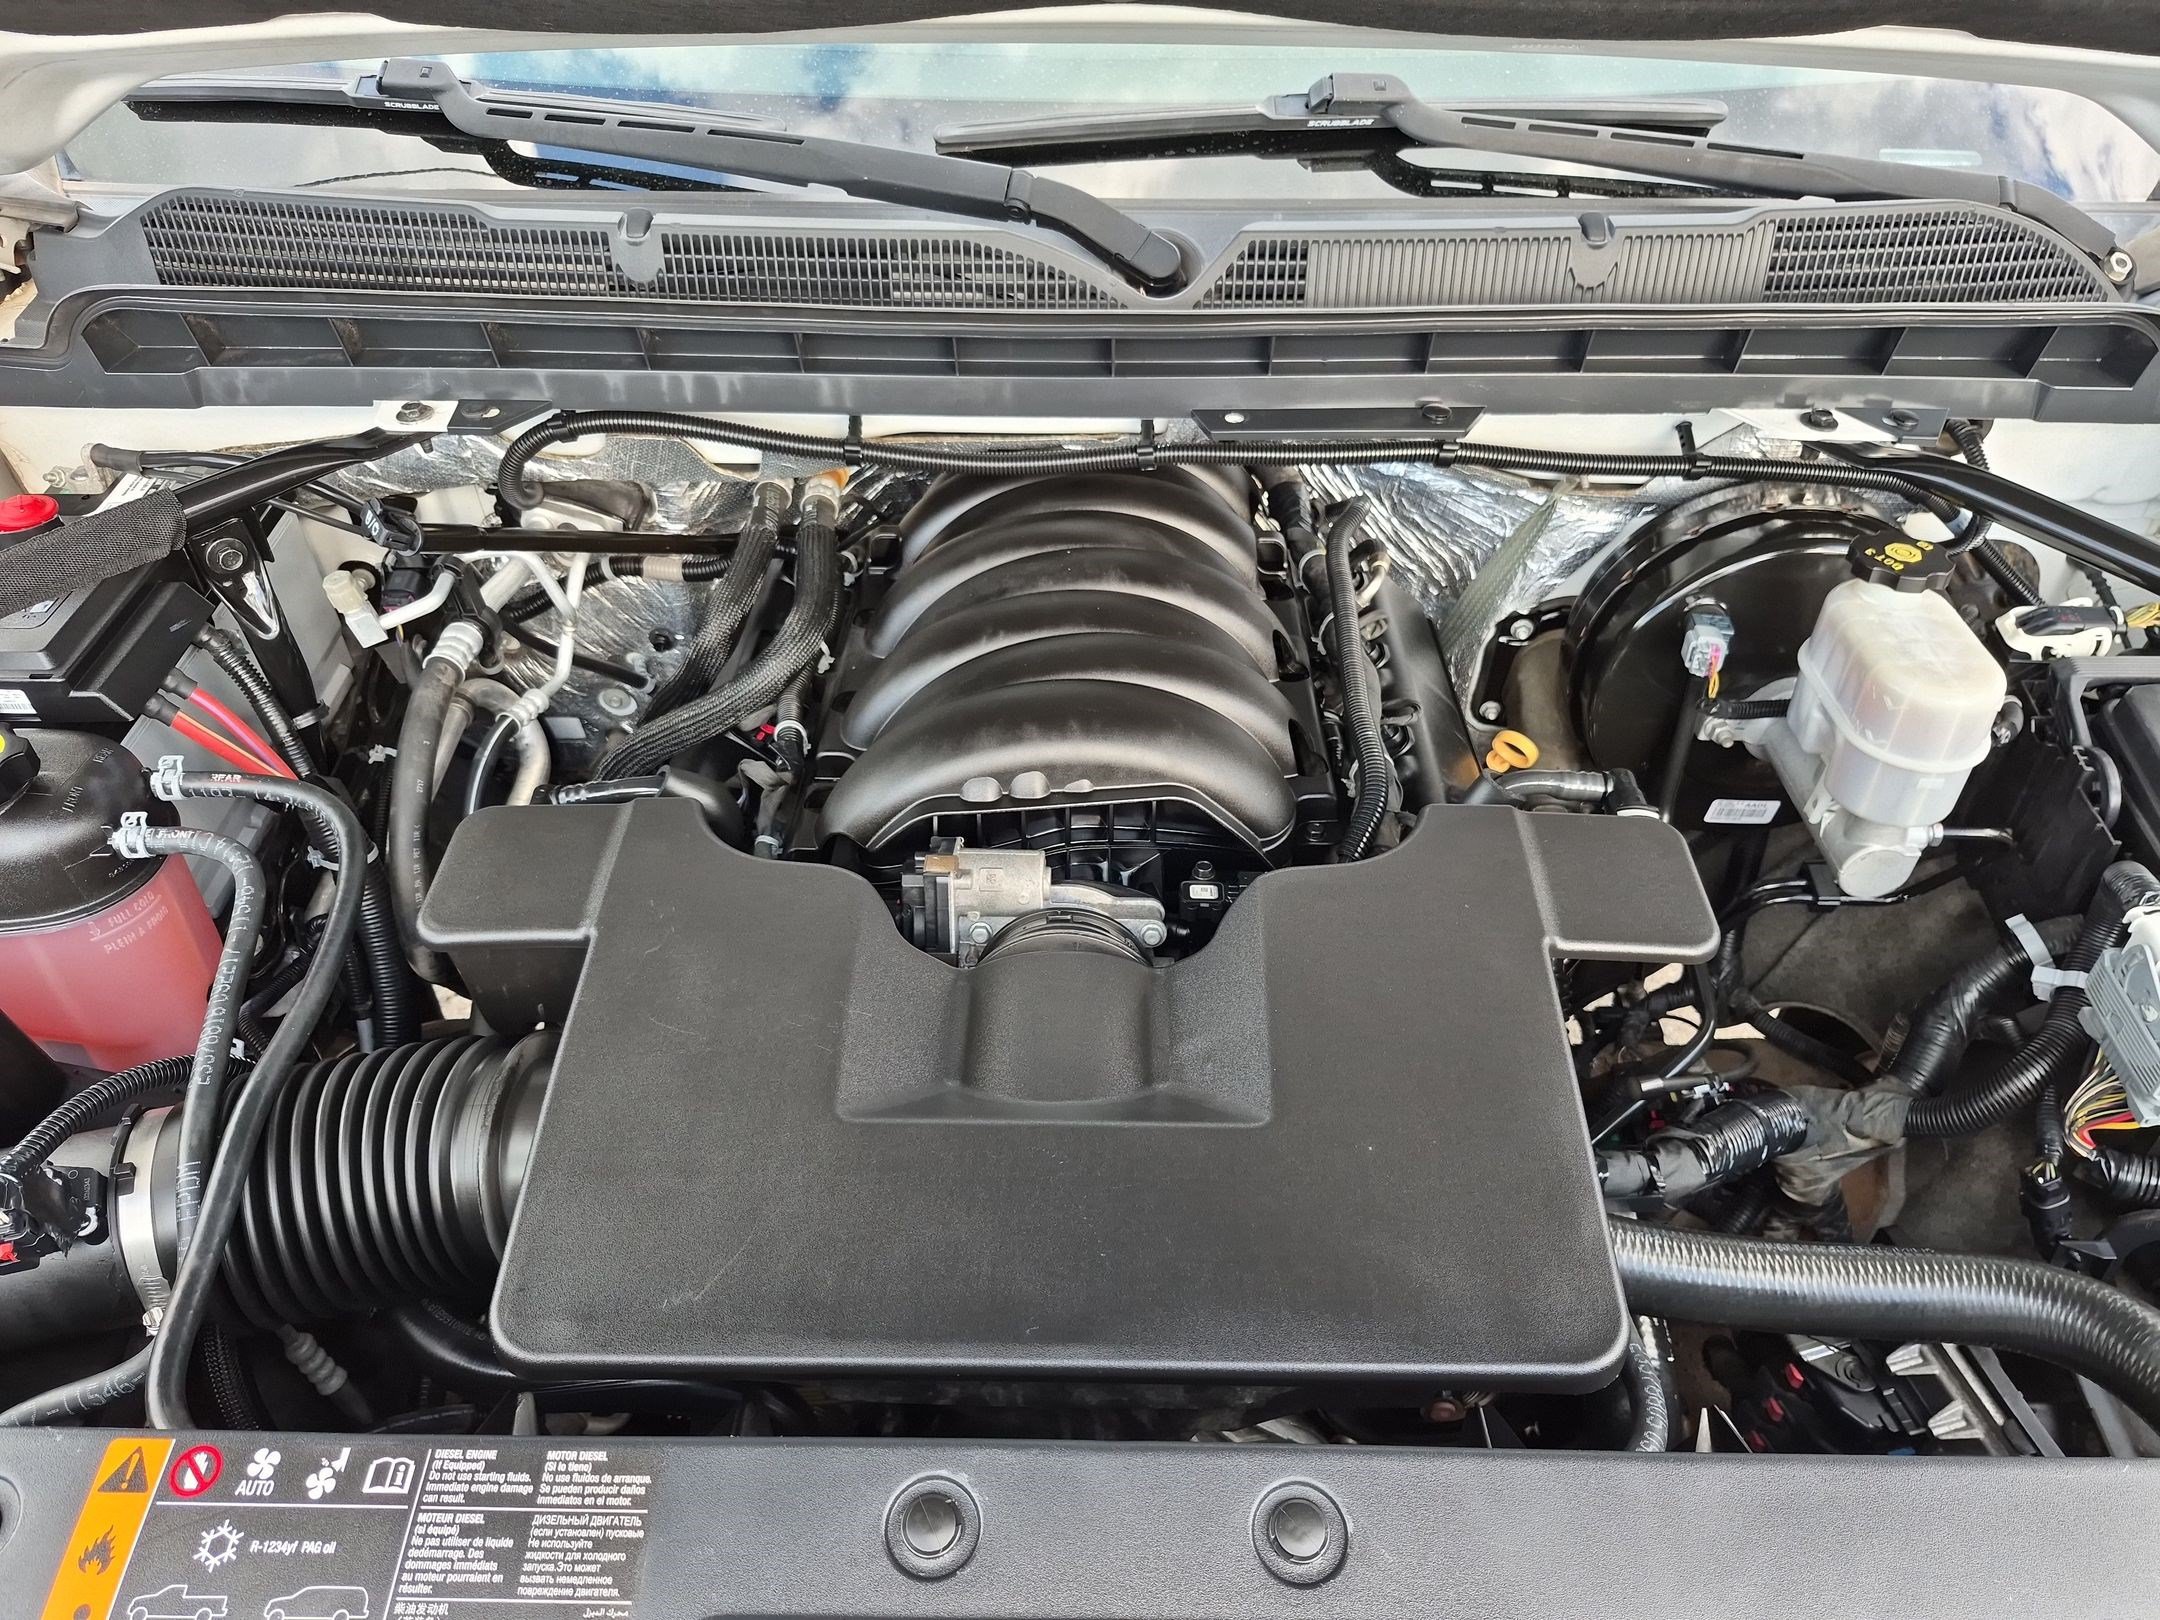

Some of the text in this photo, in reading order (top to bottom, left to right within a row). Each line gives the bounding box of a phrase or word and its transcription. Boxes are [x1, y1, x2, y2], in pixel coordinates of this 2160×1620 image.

[384, 101, 440, 111] SCRUBBLADE
[1307, 118, 1375, 128] SCRUBBLADE
[435, 1449, 498, 1460] DIESEL ENGINE
[547, 1451, 608, 1461] MOTOR DIESEL
[443, 1460, 486, 1473] Equipped)
[545, 1462, 556, 1473] (Si
[558, 1462, 566, 1472] lo
[429, 1470, 532, 1483] Do not use starting fluids.
[542, 1473, 652, 1485] No use fluidos de arranque.
[235, 1480, 275, 1496] AUTO
[426, 1482, 534, 1495] Immediate engine damage
[539, 1483, 646, 1495] Se pueden producir daños
[422, 1493, 466, 1503] can result.
[584, 1497, 595, 1505] en
[596, 1496, 605, 1505] el
[606, 1497, 631, 1506] motor.
[417, 1513, 485, 1524] MOTEUR DIESEL
[532, 1514, 642, 1527] ДИЗЕЛЬНЫЙ ДВИГАТЕЛЬ
[427, 1524, 460, 1537] équipé)
[530, 1526, 645, 1540] (если установлен) пусковые
[250, 1540, 337, 1556] R-1234yf PAG oil
[411, 1536, 514, 1549] Ne pas utiliser de liquide
[528, 1538, 593, 1550] Не используйте
[468, 1548, 484, 1558] Des
[525, 1551, 626, 1562] жидкости для холодного
[405, 1559, 452, 1572] dommages
[574, 1564, 601, 1572] может
[401, 1572, 504, 1584] au moteur pourraient en
[520, 1575, 613, 1585] вызвать немедленное
[399, 1583, 433, 1594] résulter.
[517, 1587, 620, 1598] повреждение двигателя.
[393, 1602, 449, 1616] 柴油发动机
